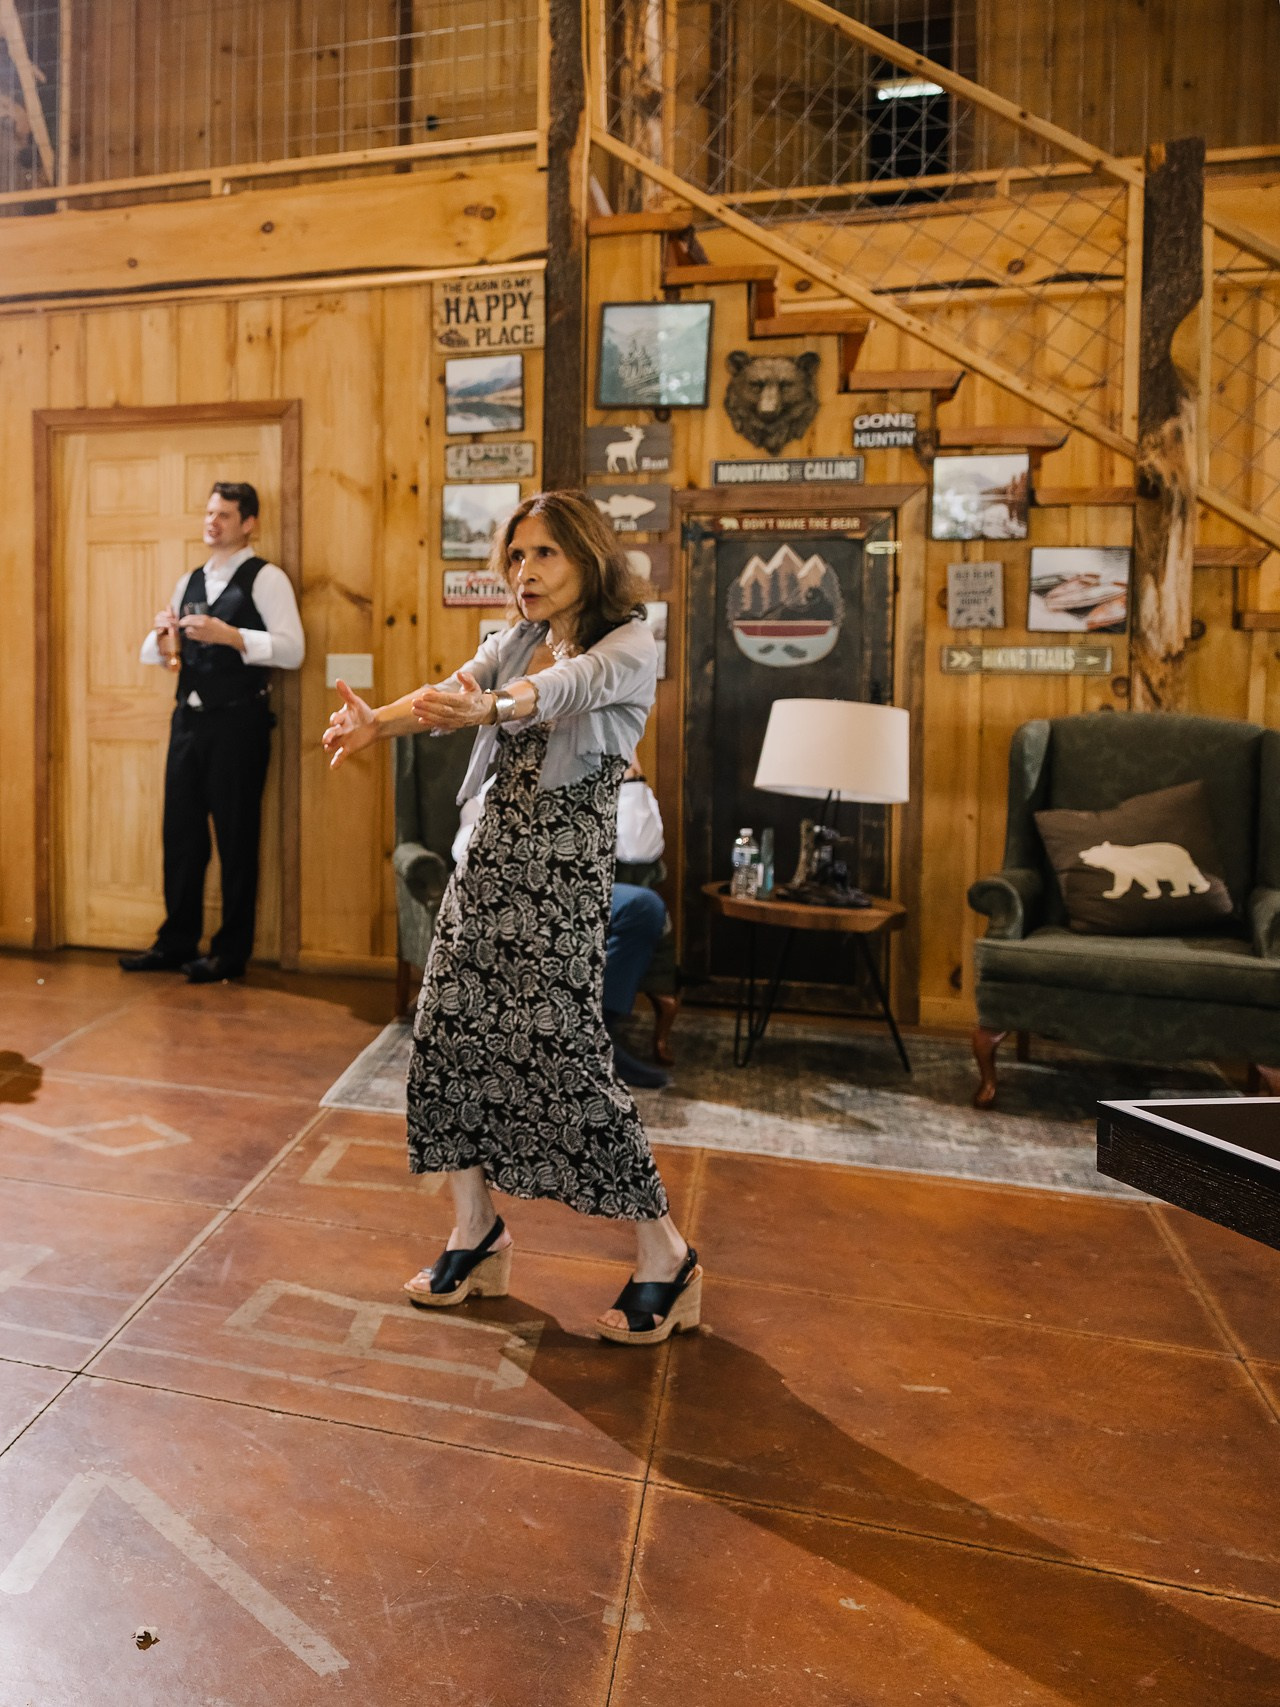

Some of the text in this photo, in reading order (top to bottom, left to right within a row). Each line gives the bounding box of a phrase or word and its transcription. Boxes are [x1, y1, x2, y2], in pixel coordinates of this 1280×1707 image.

[442, 283, 462, 292] THE
[466, 281, 498, 291] CABIN
[515, 279, 531, 287] MY
[445, 291, 533, 324] HAPPY
[475, 324, 534, 346] PLACE
[853, 413, 916, 429] GONE
[718, 463, 790, 482] MOUNTAINS
[804, 461, 857, 480] CALLING
[742, 518, 775, 530] DON'T
[808, 518, 829, 530] THE
[830, 518, 861, 530] BEAR
[1030, 648, 1075, 670] TRAILS
